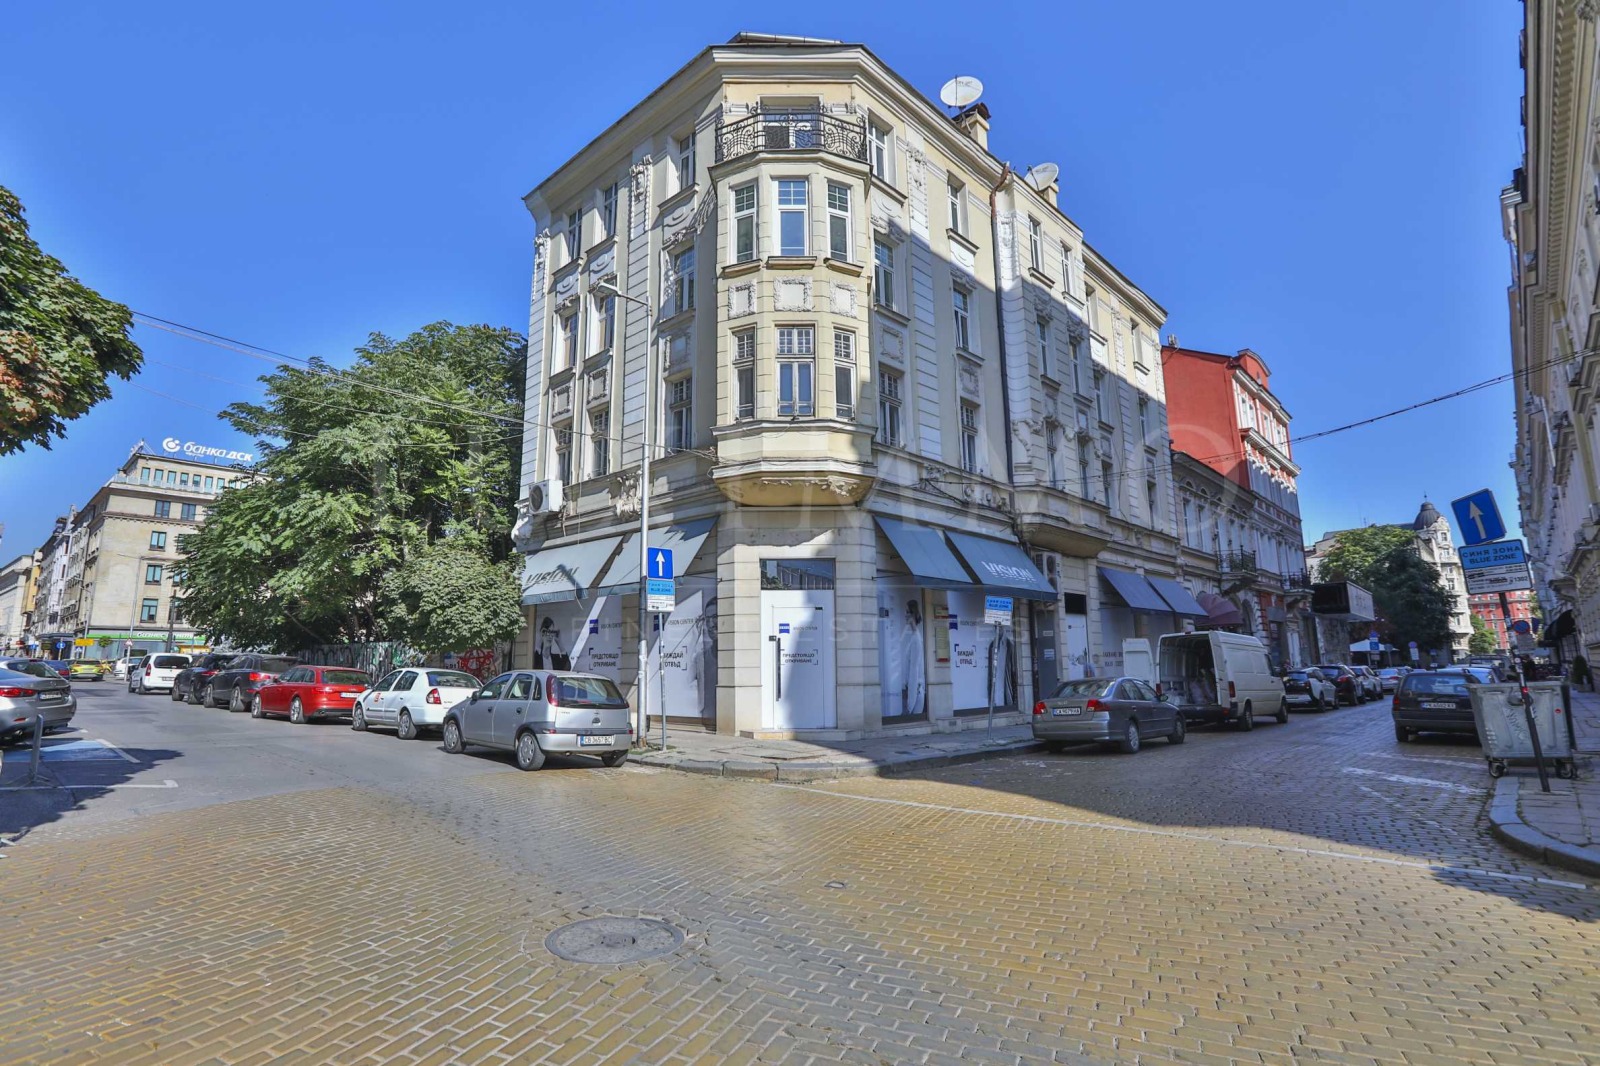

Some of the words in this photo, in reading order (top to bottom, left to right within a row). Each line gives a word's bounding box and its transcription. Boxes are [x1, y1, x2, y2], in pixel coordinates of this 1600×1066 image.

[183, 441, 227, 457] банка
[1462, 549, 1490, 558] СИНЯ
[1492, 545, 1520, 555] ЗОНА
[1469, 556, 1492, 564] BLUE
[1494, 553, 1517, 562] ZONE
[526, 566, 580, 586] VISION
[981, 561, 1037, 583] VISION
